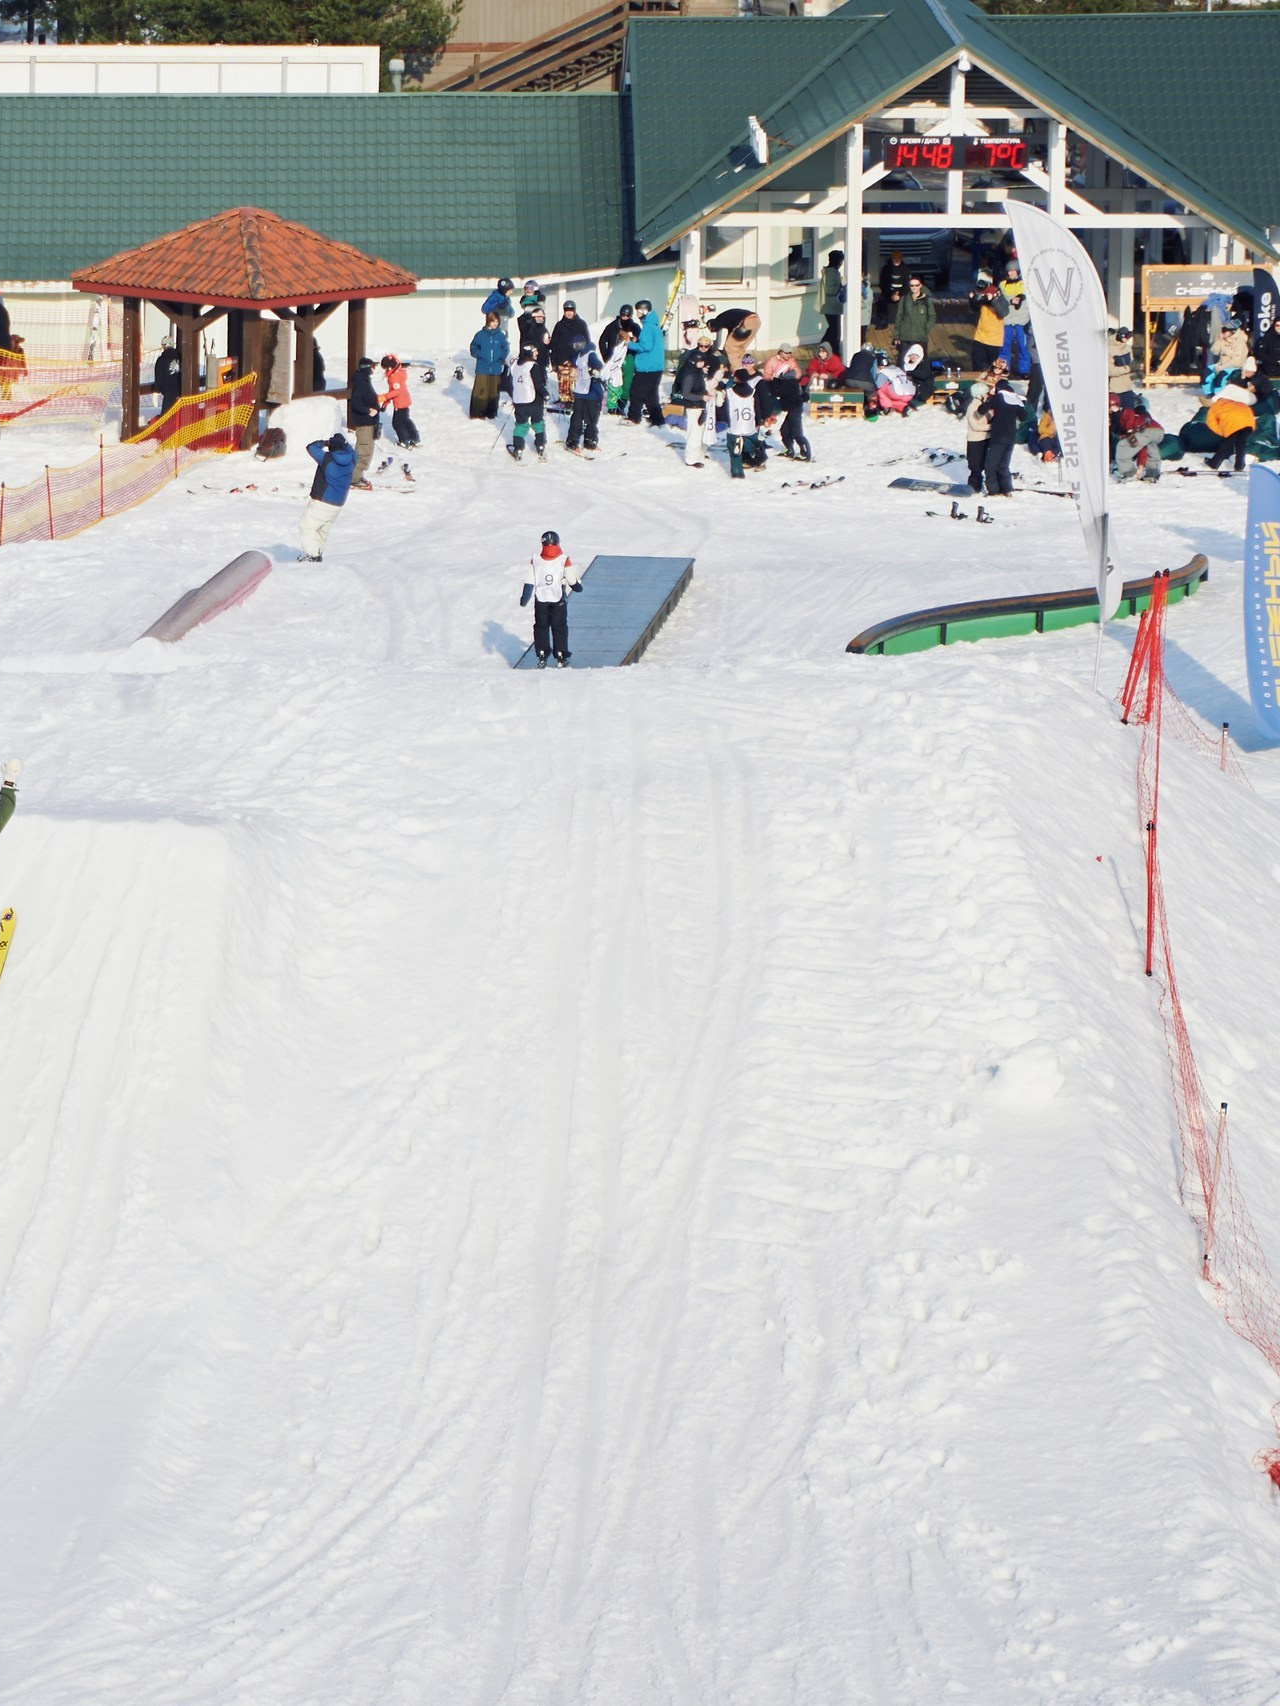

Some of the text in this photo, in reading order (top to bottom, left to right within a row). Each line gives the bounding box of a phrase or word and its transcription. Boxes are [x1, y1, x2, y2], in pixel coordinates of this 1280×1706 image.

[922, 145, 954, 169] 48
[517, 375, 524, 384] 4
[734, 407, 752, 421] 16
[544, 574, 554, 586] 9
[1253, 523, 1272, 708] ГОРНОЛЫЖНЫЙ КУРОРТ
